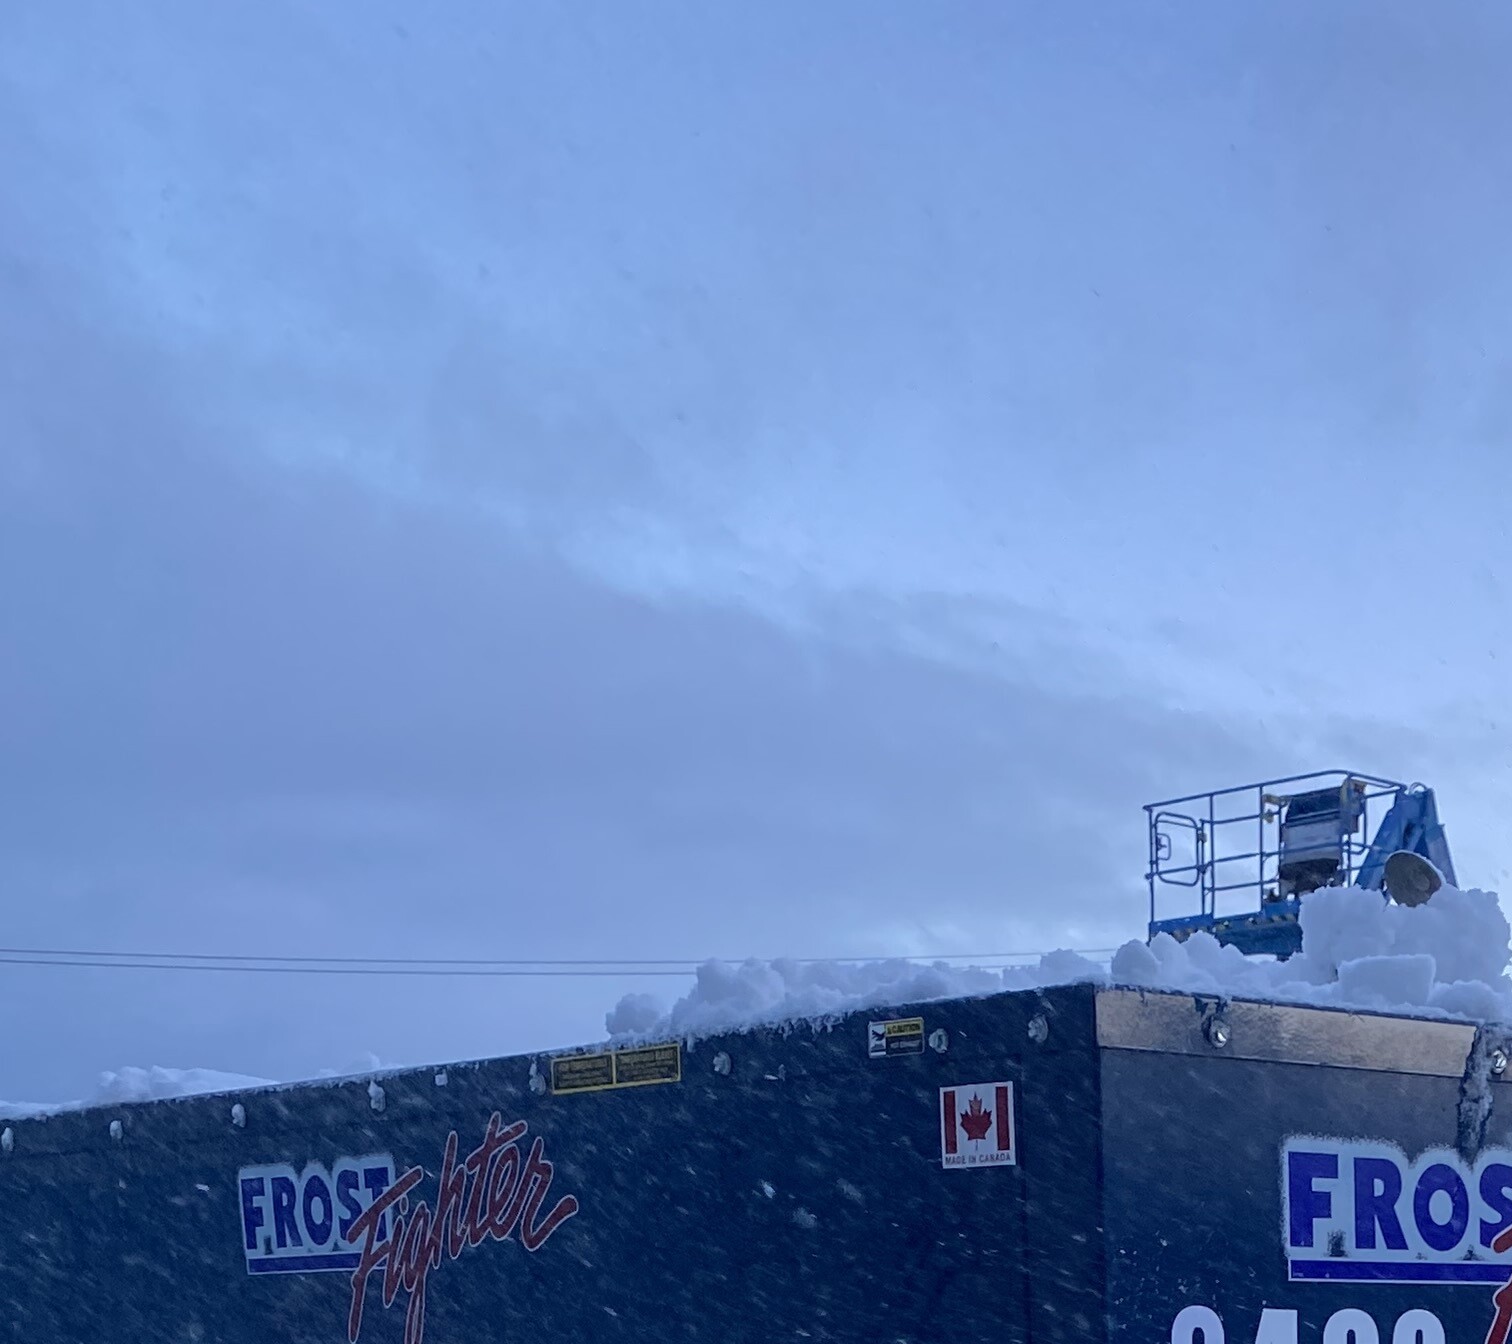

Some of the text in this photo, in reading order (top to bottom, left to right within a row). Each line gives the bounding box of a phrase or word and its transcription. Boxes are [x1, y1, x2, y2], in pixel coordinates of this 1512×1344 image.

[945, 1152, 1011, 1165] MADE IN CANADA
[241, 1167, 389, 1250] FROST
